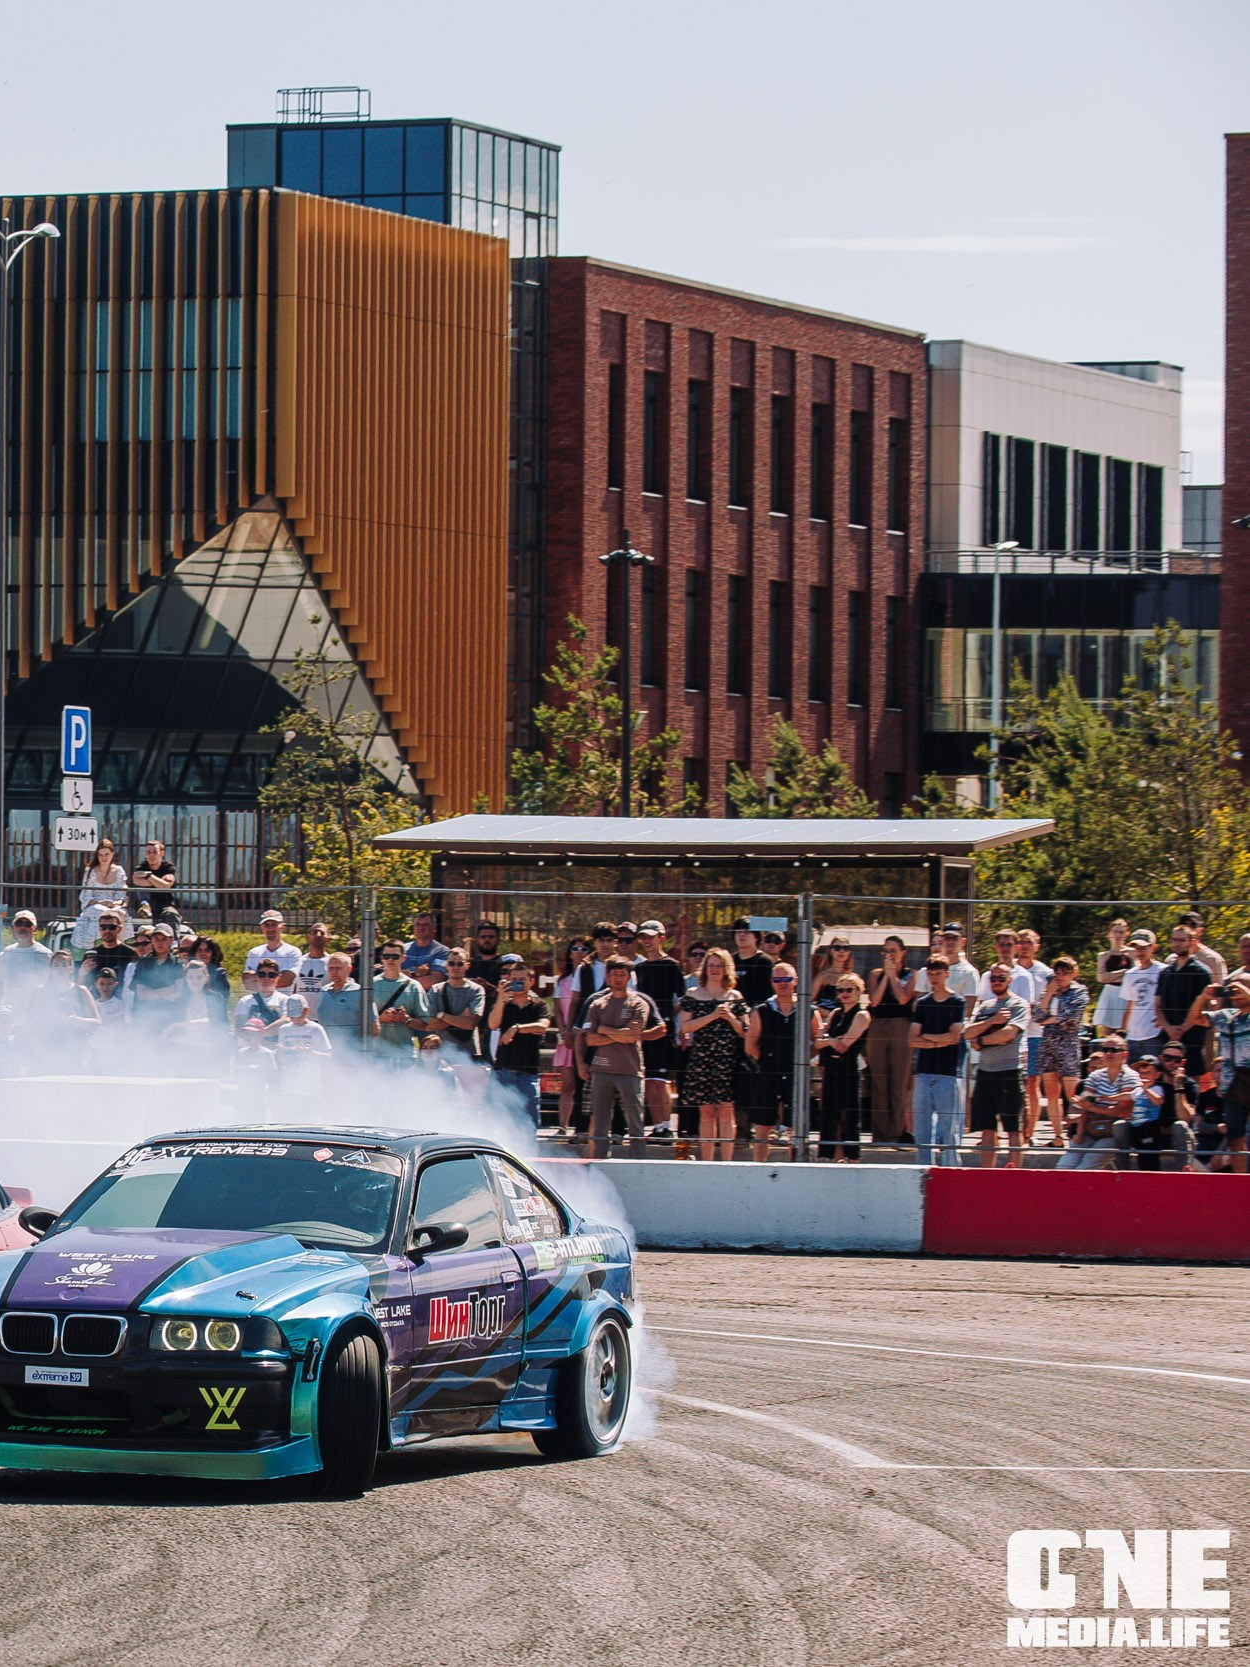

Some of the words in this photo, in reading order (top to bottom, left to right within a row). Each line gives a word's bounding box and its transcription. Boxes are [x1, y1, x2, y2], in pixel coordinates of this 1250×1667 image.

[70, 715, 87, 766] P
[391, 1305, 412, 1318] LAKE
[428, 1291, 506, 1345] ШинТорг
